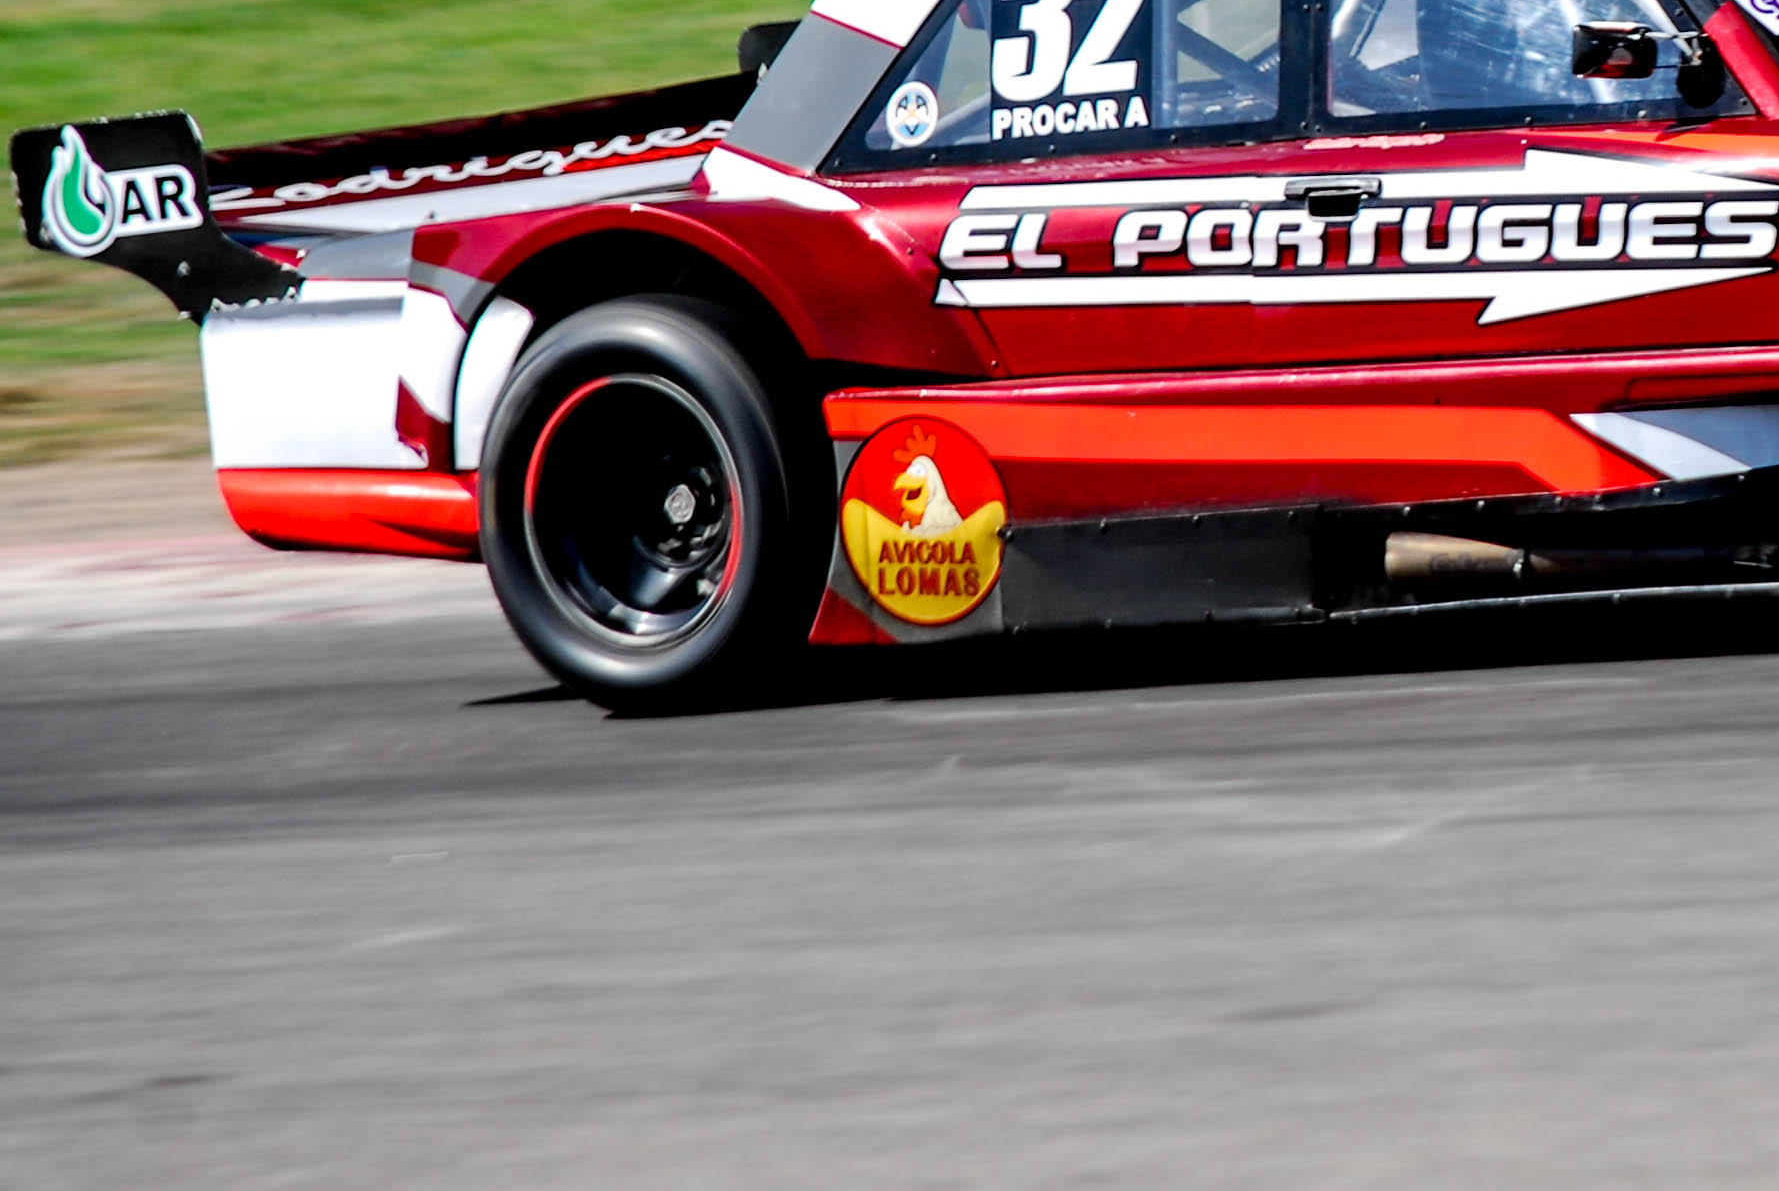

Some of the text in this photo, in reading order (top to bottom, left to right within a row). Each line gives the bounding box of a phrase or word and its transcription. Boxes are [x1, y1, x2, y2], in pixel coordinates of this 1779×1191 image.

[991, 96, 1149, 141] PROCAR A
[121, 175, 192, 224] AR
[938, 213, 1063, 271] EL
[879, 539, 976, 564] AVICOLA
[878, 566, 981, 596] LOMAS
